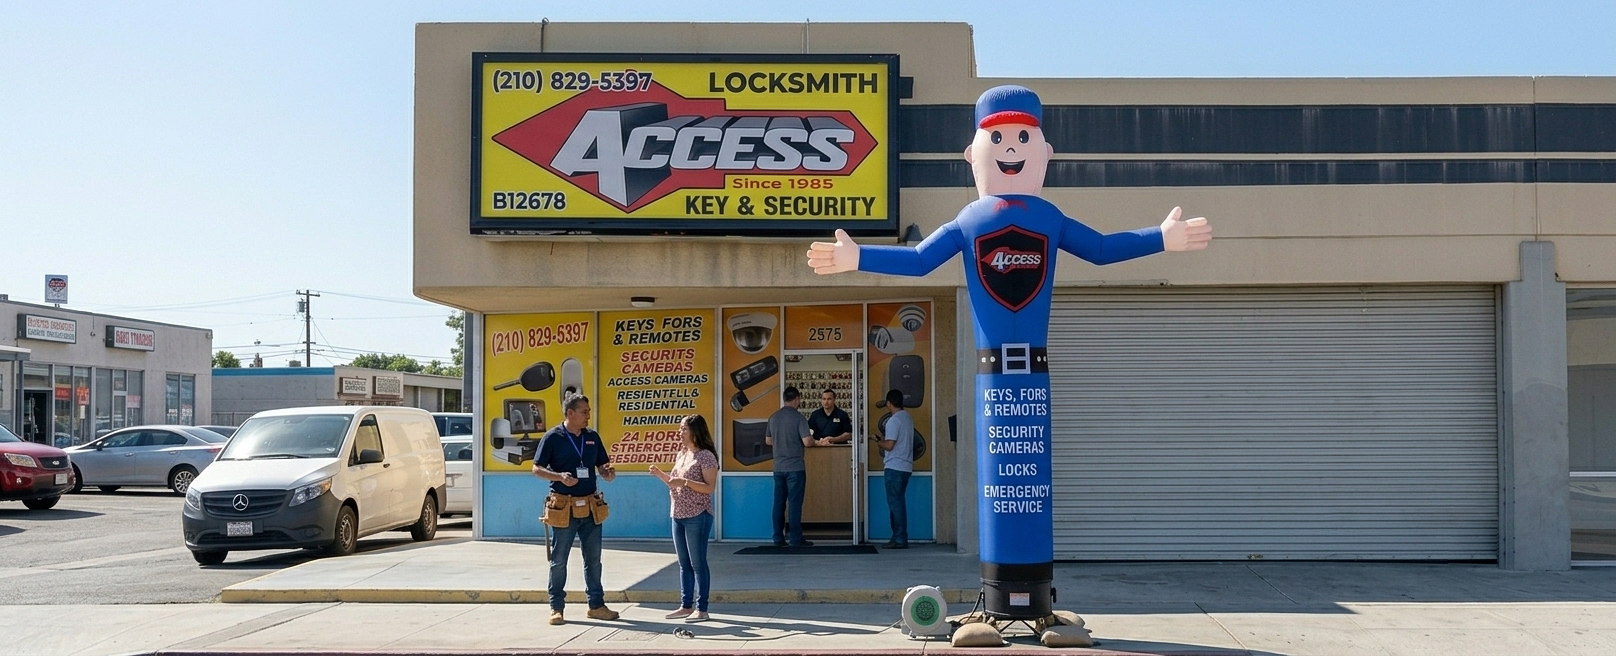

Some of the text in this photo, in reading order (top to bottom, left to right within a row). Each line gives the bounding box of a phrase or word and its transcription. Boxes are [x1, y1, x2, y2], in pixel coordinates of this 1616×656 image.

[493, 70, 653, 93] (210) 829-5397
[709, 72, 878, 93] LOCKSMITH
[732, 178, 834, 189] Since 1985
[493, 192, 566, 210] B12678
[685, 195, 876, 216] KEY & SECURITY
[615, 316, 703, 332] KEYS FORS
[613, 330, 701, 346] & REMOTES
[808, 327, 842, 341] 2575
[492, 330, 524, 356] (210)
[621, 348, 695, 363] SECURITS
[607, 374, 709, 387] ACCESS CAMERAS
[984, 388, 1047, 402] KEYS, FORS
[618, 400, 696, 411] RESIDENTIAL
[984, 404, 1047, 416] & REMOTES
[988, 425, 1044, 438] SECURITY
[989, 441, 1044, 454] CAMERAS
[998, 463, 1037, 476] LOCKS
[984, 485, 1050, 498] EMERGENCY
[993, 501, 1043, 513] SERVICE
